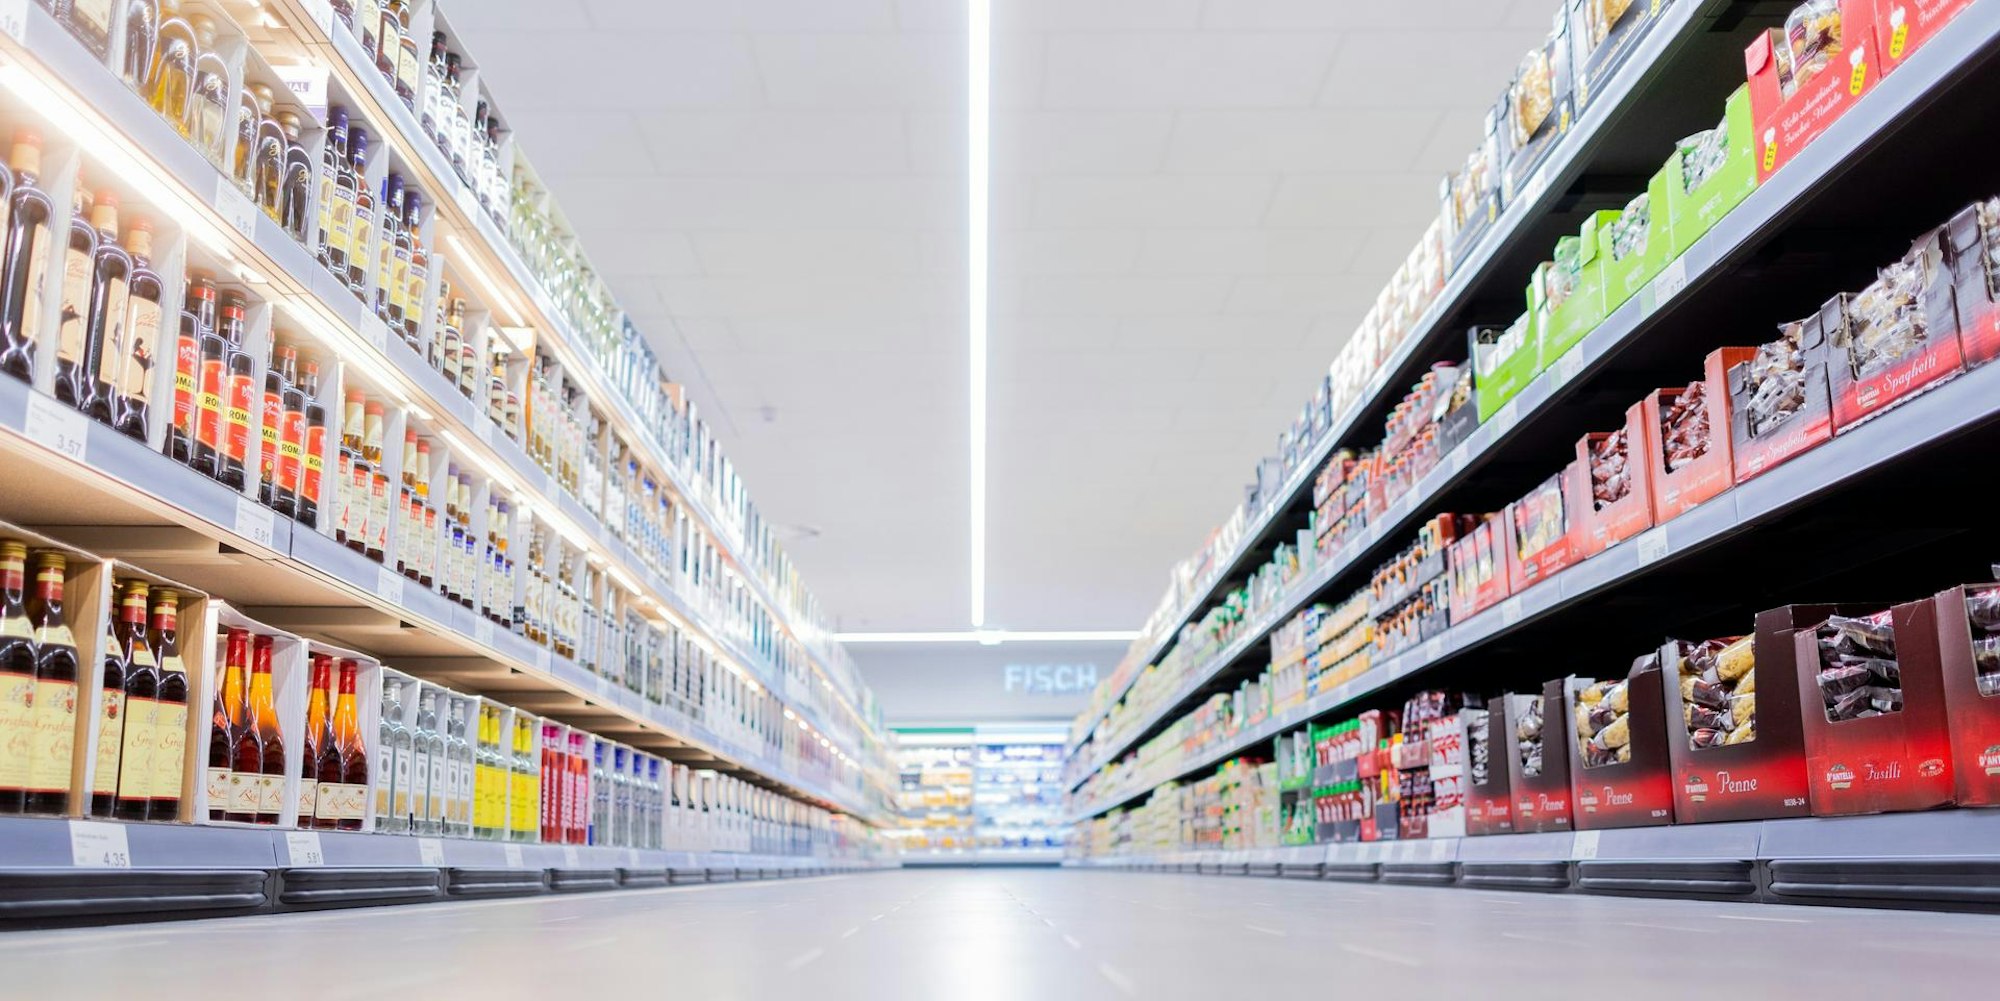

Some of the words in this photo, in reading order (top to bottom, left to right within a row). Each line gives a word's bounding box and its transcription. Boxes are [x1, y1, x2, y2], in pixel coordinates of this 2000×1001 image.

[1883, 353, 1937, 394] Spaghetti
[56, 434, 82, 456] 3.57
[1766, 431, 1808, 460] Spaghetti
[341, 505, 349, 528] 4
[254, 527, 270, 543] 5.81
[360, 518, 367, 540] 4
[378, 526, 386, 548] 4
[1004, 663, 1097, 692] FISCH
[1863, 760, 1901, 781] Fusilli
[1716, 771, 1758, 794] Penne
[1538, 793, 1565, 812] Penne
[1603, 786, 1633, 806] Penne
[103, 851, 127, 868] 4.35
